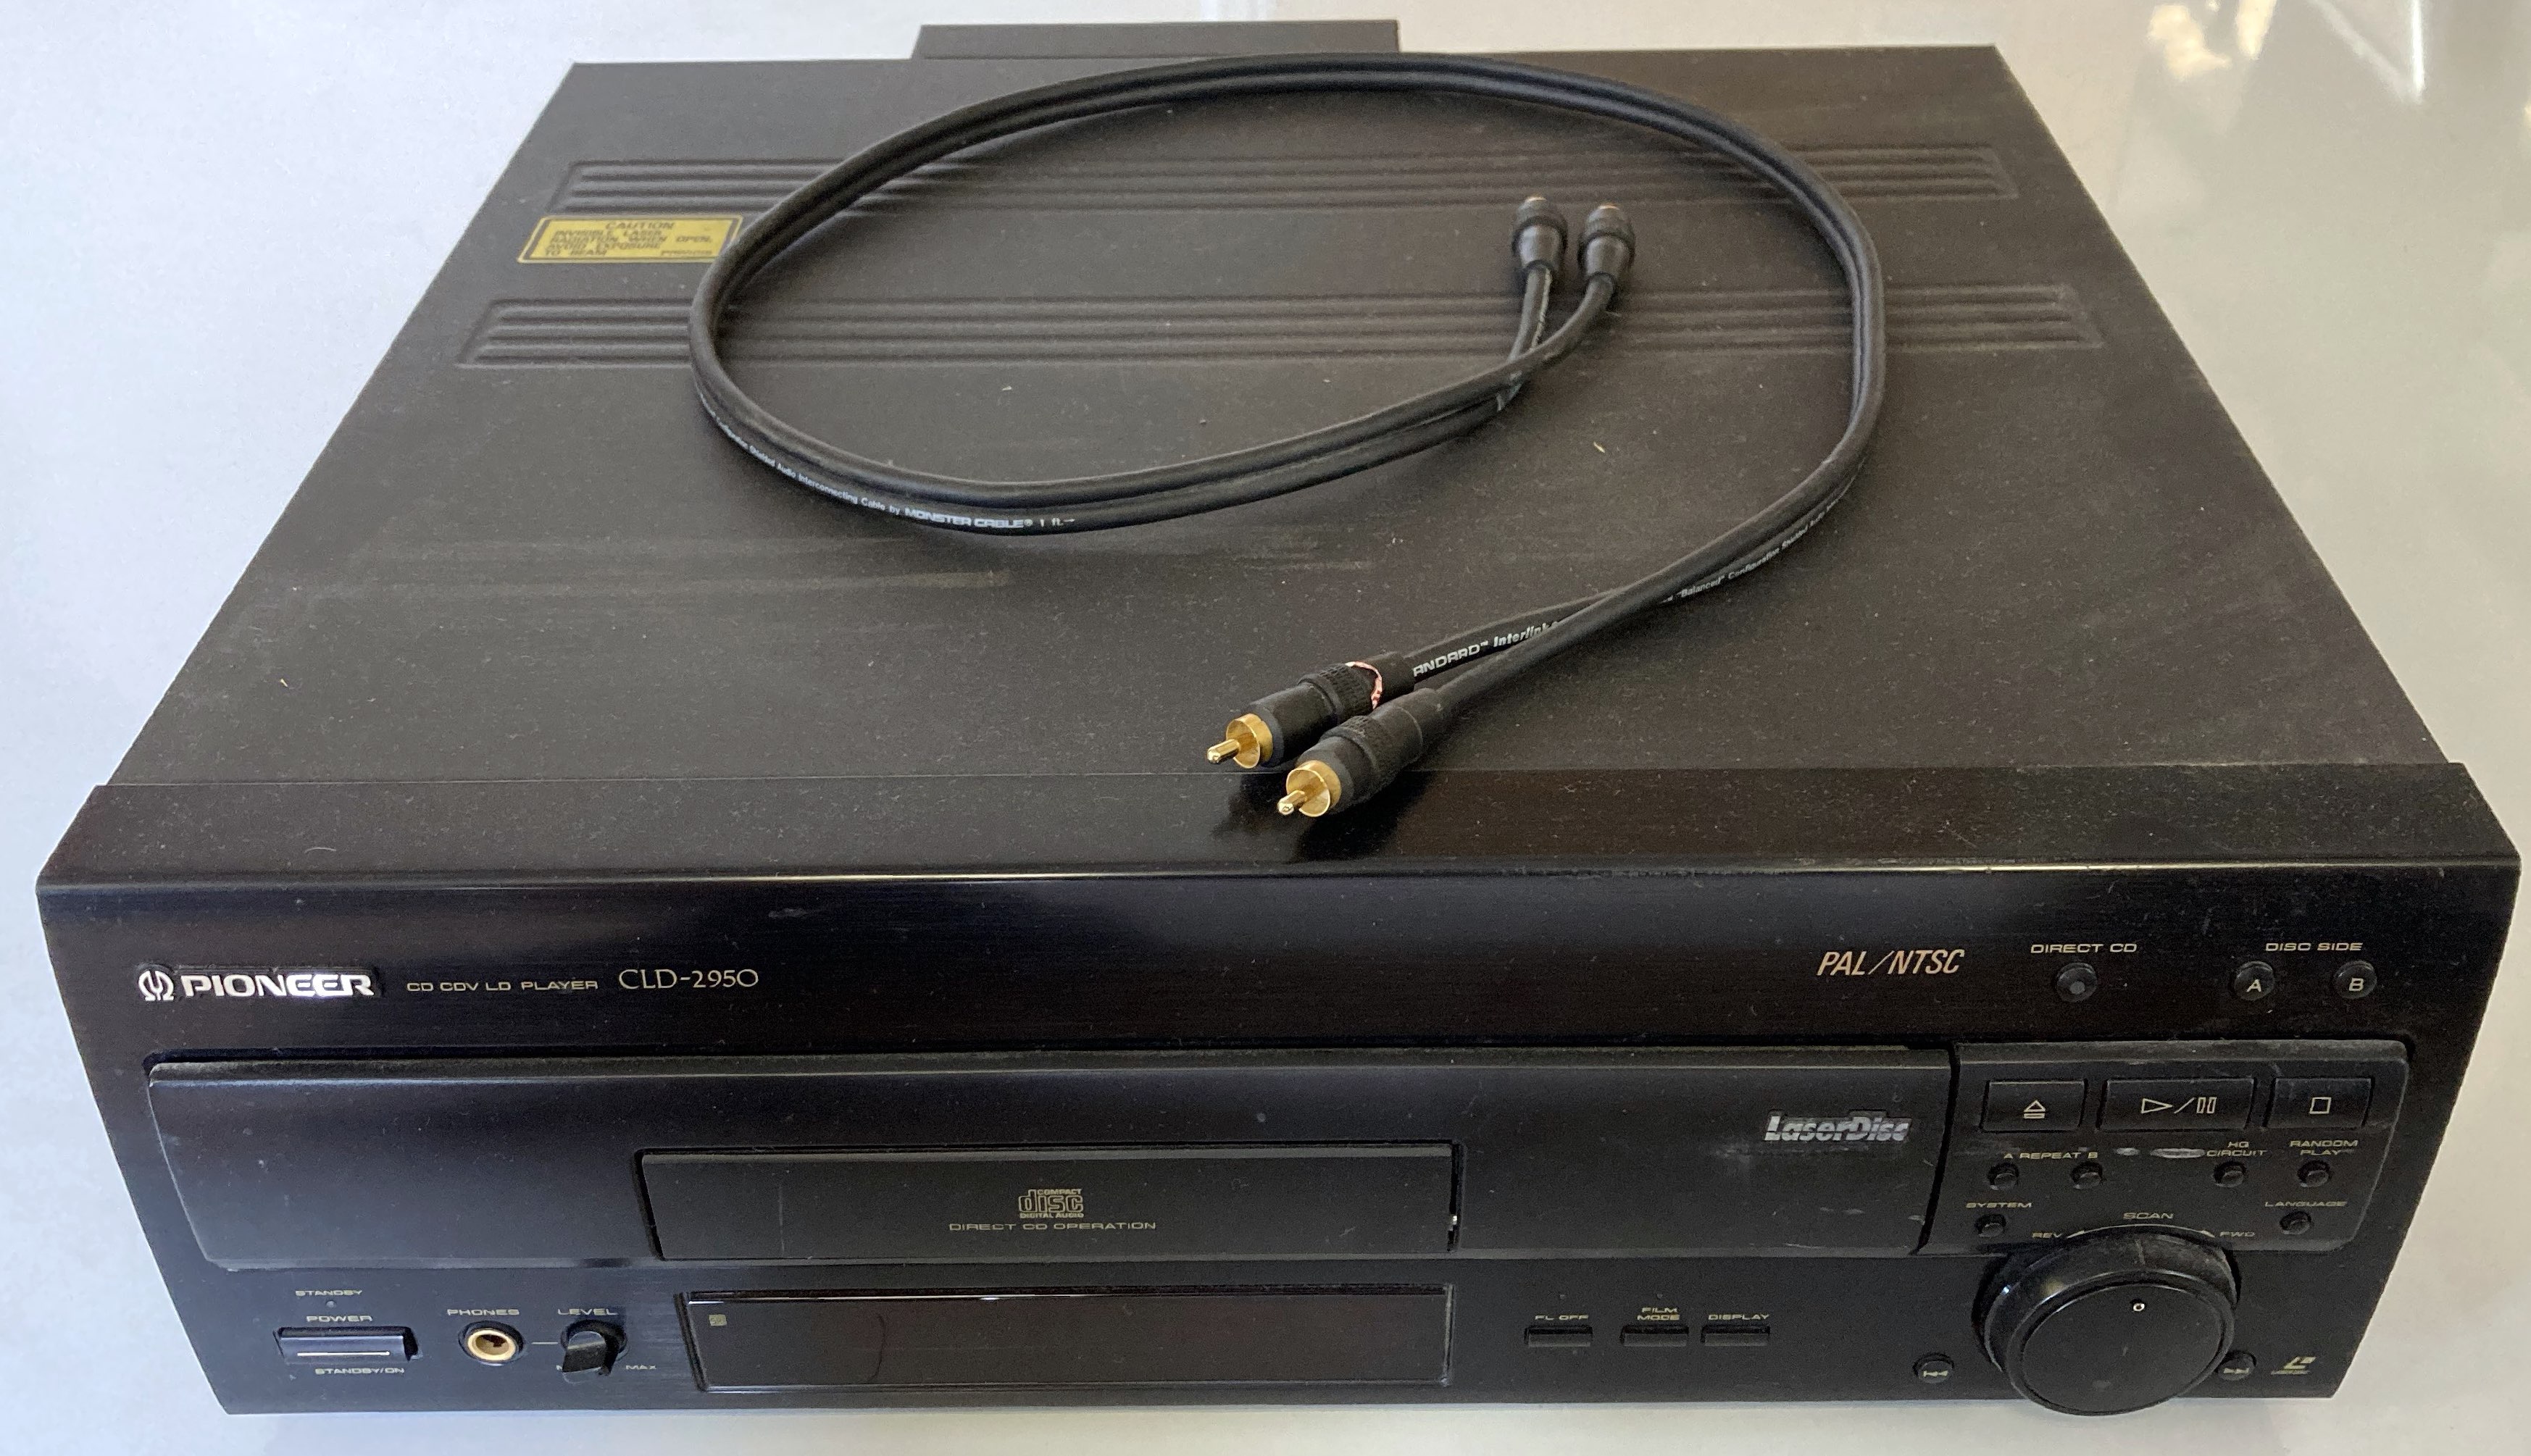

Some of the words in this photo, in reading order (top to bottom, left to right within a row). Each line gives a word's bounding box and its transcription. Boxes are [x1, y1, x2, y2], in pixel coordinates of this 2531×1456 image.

[861, 497, 885, 511] Cable
[889, 505, 900, 515] by
[905, 507, 972, 526] MONSTER
[2030, 943, 2103, 953] DIRECT
[2110, 943, 2137, 953] CD
[2265, 942, 2311, 952] DISC
[2317, 942, 2363, 951] SIDE
[1817, 949, 1965, 976] PAL/NTSC
[618, 968, 759, 990] CLD-2950
[2348, 977, 2364, 992] B
[180, 974, 375, 997] PIONEER
[406, 982, 433, 992] CD
[440, 982, 478, 991] CDV
[485, 982, 512, 991] LD
[521, 980, 599, 991] PLAYER
[2246, 979, 2262, 992] A
[1764, 1116, 1910, 1142] LaserDisc
[2123, 1211, 2173, 1220] SCAN
[1054, 1221, 1156, 1230] OPERATION
[557, 1308, 618, 1316] LEVEL
[314, 1367, 405, 1376] STANDBY/ON
